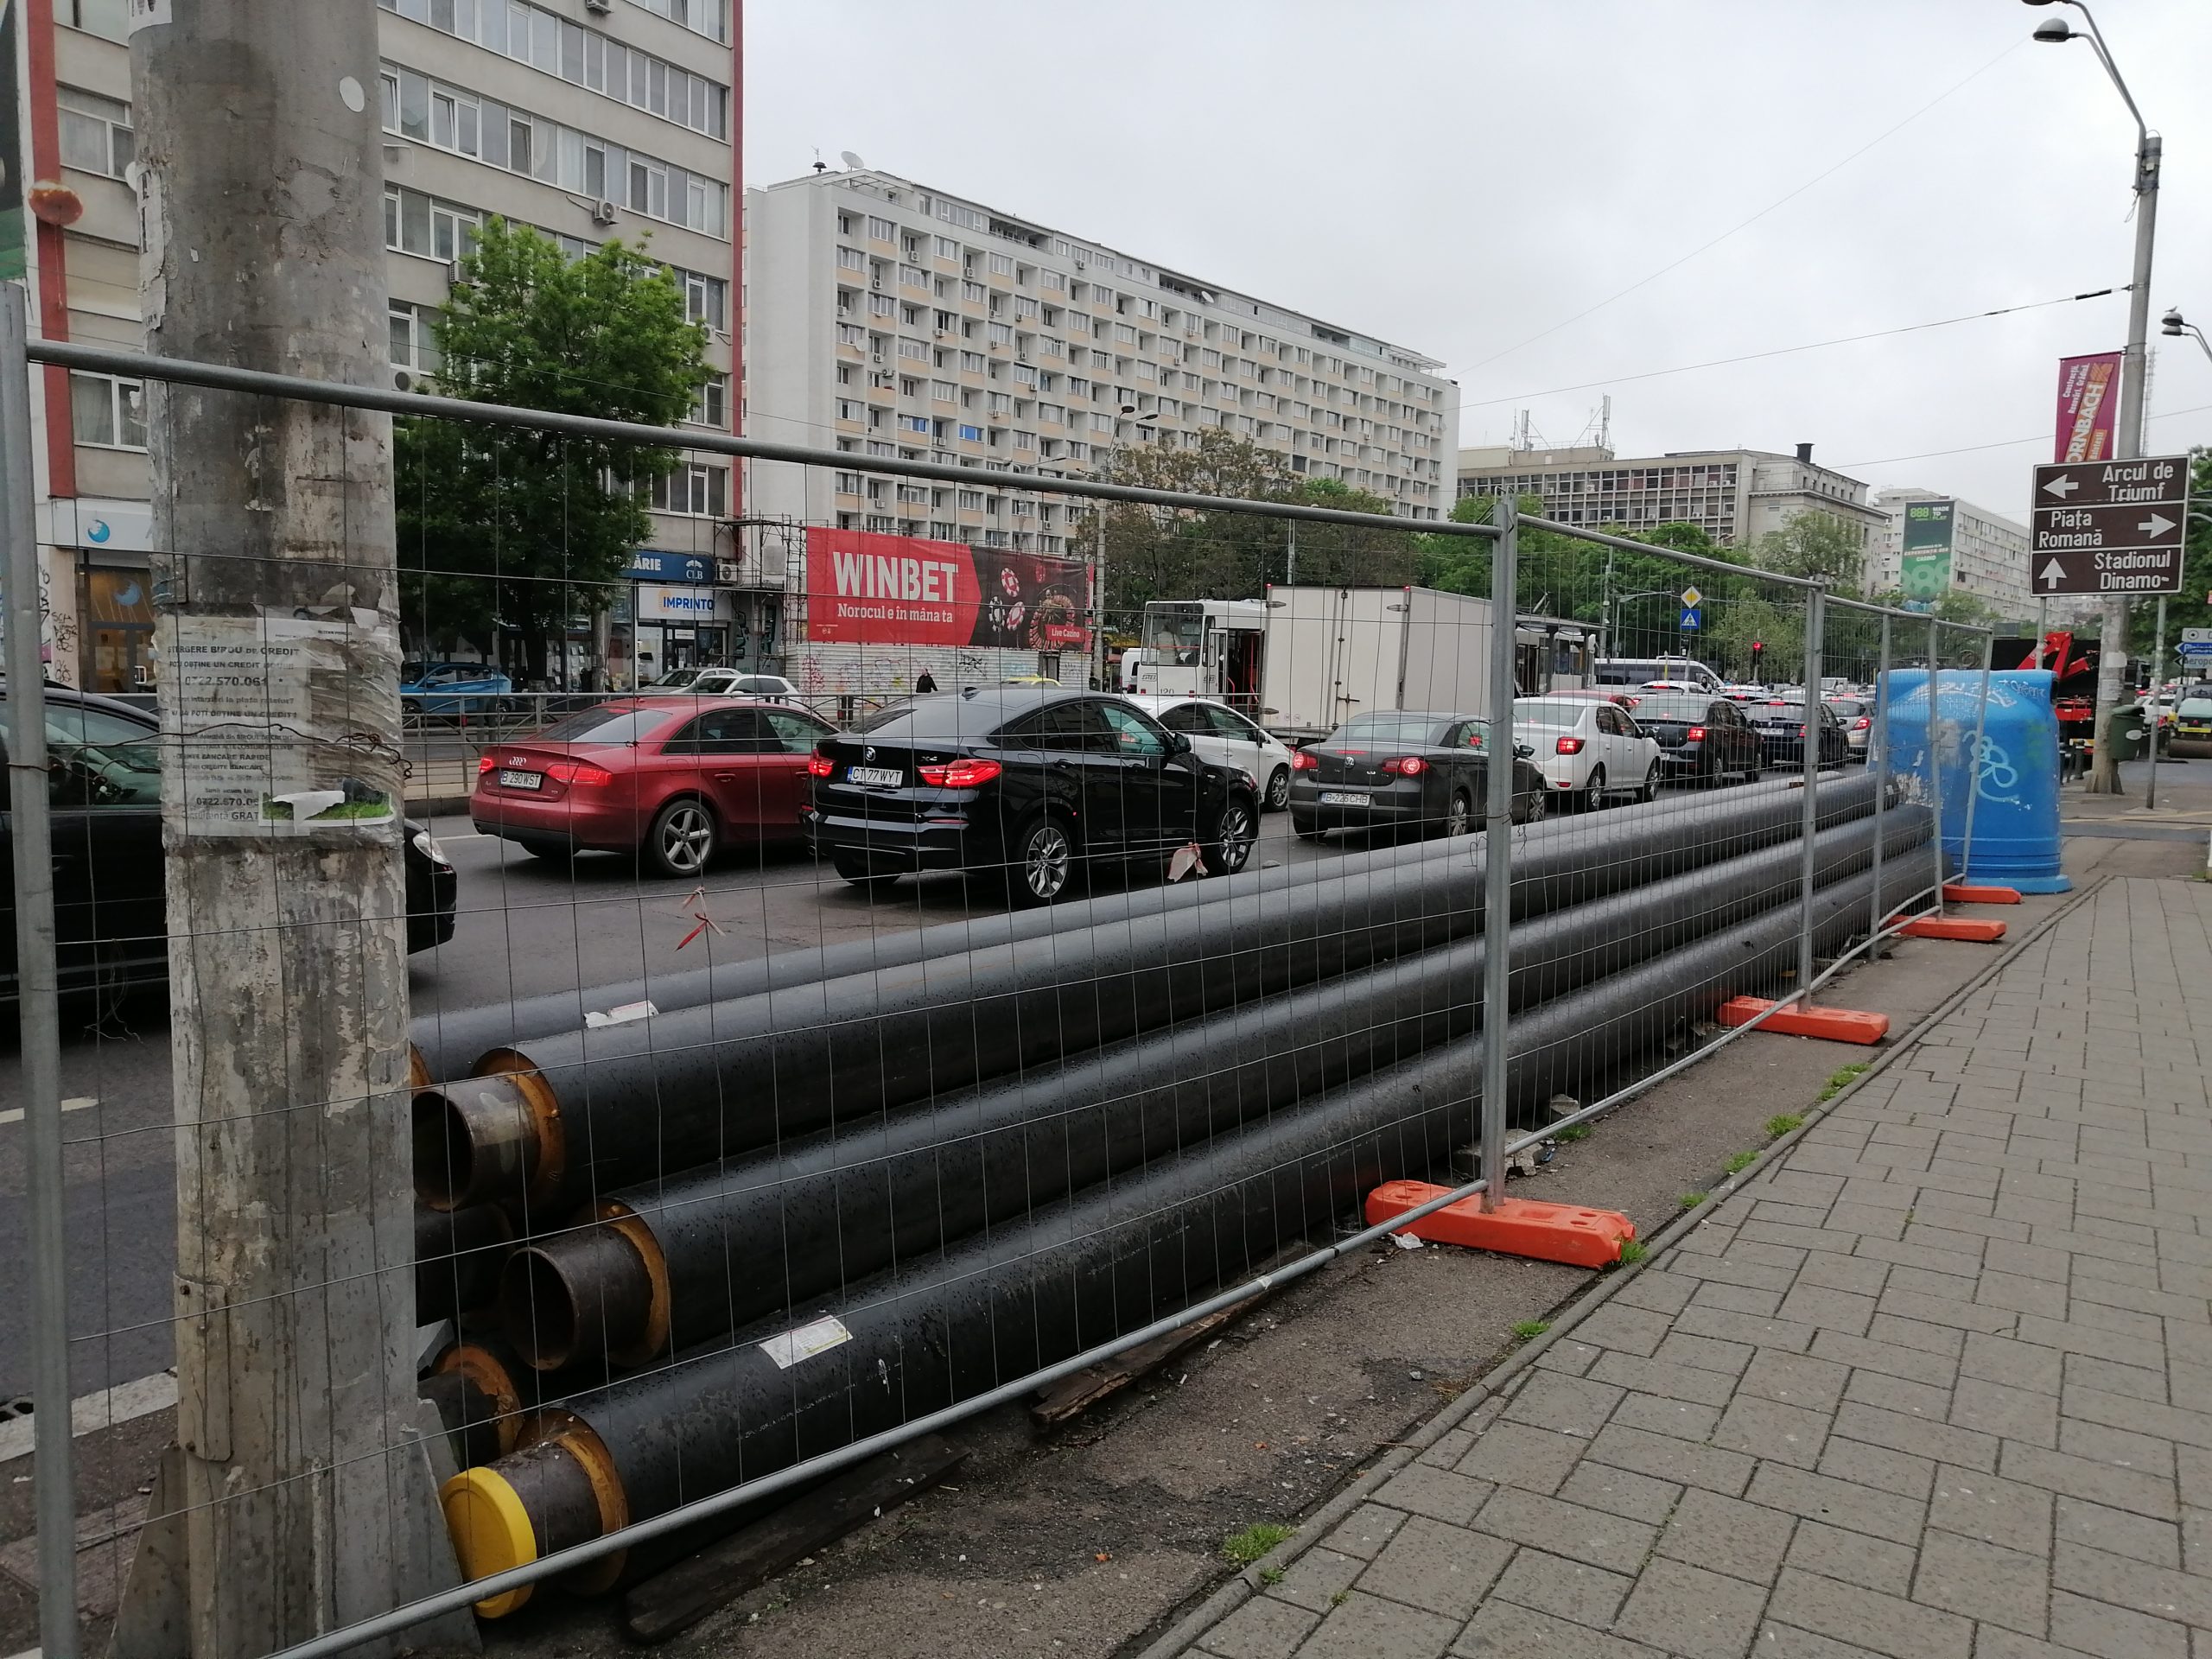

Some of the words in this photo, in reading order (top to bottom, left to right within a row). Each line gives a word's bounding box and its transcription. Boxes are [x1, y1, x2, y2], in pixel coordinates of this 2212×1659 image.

[2066, 384, 2105, 463] ORNBACH
[2101, 462, 2148, 483] Arcul
[2153, 461, 2174, 479] de
[2107, 482, 2166, 503] Triumf
[1910, 506, 1929, 518] 888
[2050, 510, 2093, 530] Piața
[2038, 529, 2103, 549] Romană
[2094, 550, 2171, 570] Stadionul
[685, 570, 703, 580] CLB
[832, 550, 959, 603] WINBET
[663, 596, 714, 611] IMPRINTO
[836, 602, 885, 620] Norocul
[887, 607, 894, 619] e
[896, 604, 907, 620] în
[909, 606, 940, 622] mâna
[942, 610, 954, 623] ta
[1051, 626, 1063, 637] Live
[1063, 628, 1080, 639] Cazino
[261, 647, 300, 656] CREDIT
[502, 772, 508, 783] B
[510, 772, 523, 785] 290
[524, 774, 539, 786] WST
[852, 767, 864, 779] CT
[868, 769, 880, 781] 77
[880, 770, 900, 783] WYT
[195, 797, 259, 806] 0722.570.06
[1350, 794, 1368, 804] CHB
[232, 810, 259, 820] GRAT
